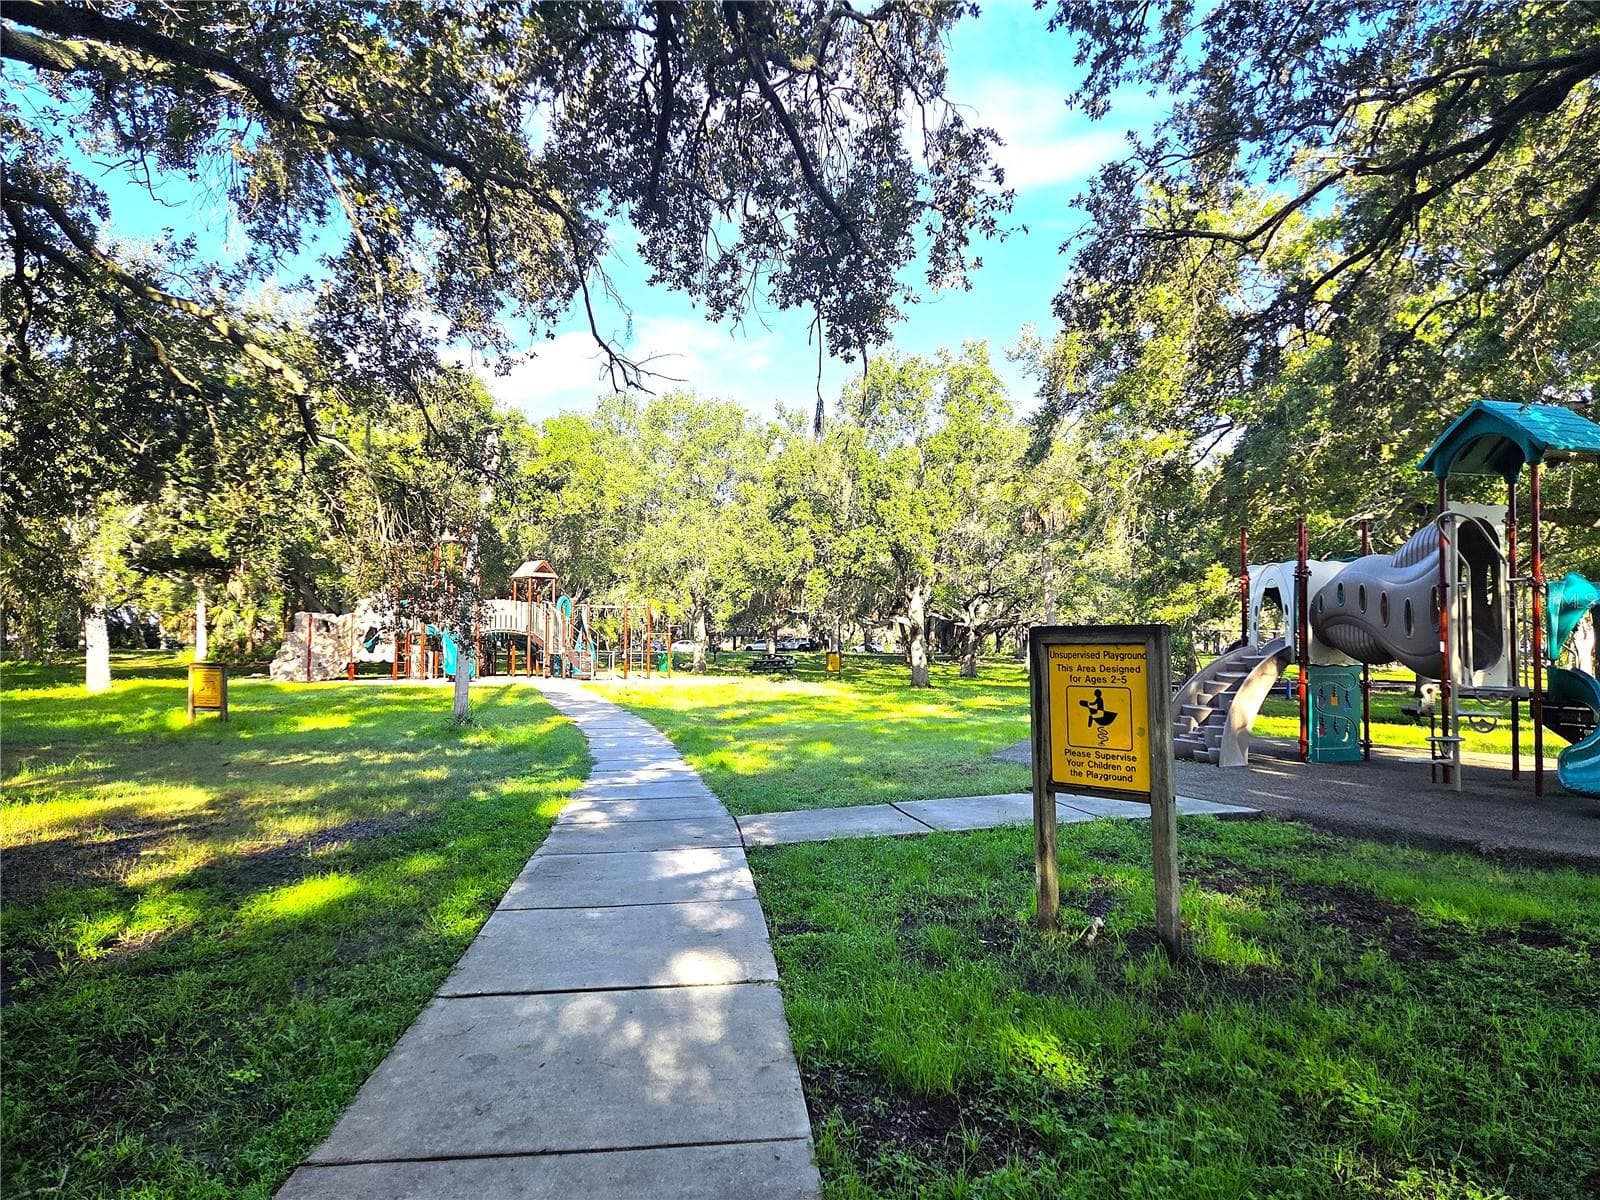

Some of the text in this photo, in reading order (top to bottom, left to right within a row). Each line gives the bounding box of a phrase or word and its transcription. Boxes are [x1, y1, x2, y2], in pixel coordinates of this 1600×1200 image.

[1050, 651, 1100, 660] Unsupervised
[1056, 664, 1141, 675] This Area Designed
[1085, 675, 1107, 685] Ages
[1110, 675, 1127, 684] 2-5
[1064, 749, 1137, 762] Please Supervise
[1066, 759, 1136, 772] Your Children on
[1070, 769, 1133, 782] the Playground
